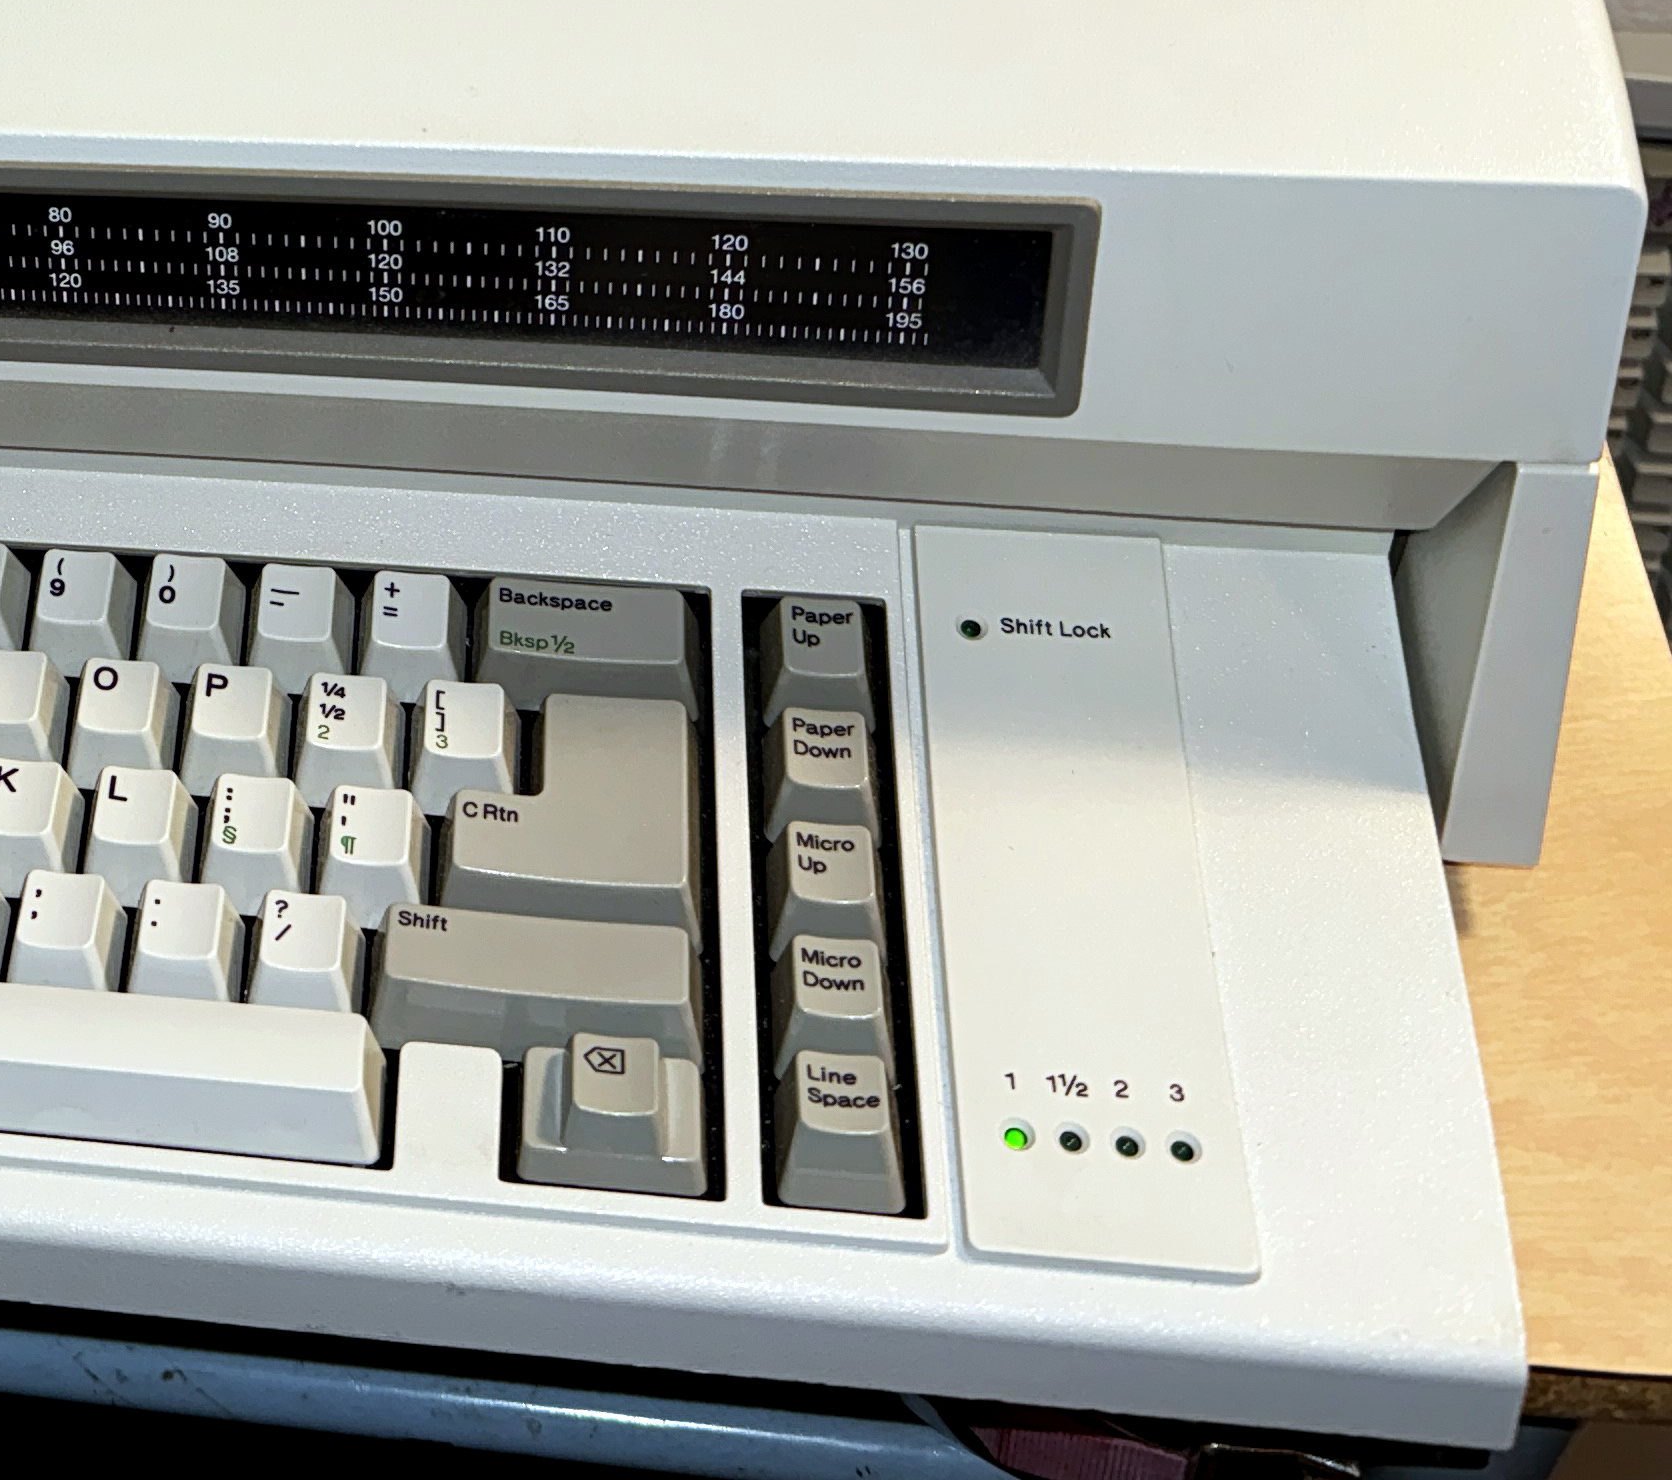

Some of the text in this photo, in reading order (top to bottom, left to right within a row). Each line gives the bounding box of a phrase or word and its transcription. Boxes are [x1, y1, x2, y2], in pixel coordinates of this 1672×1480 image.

[49, 207, 71, 222] 80
[208, 213, 232, 228] 90
[368, 220, 402, 236] 100
[536, 227, 570, 243] 110
[712, 235, 748, 251] 120
[892, 243, 928, 259] 130
[51, 240, 74, 255] 96
[206, 247, 239, 262] 108
[369, 254, 402, 269] 120
[535, 261, 570, 277] 132
[711, 269, 745, 285] 144
[889, 278, 925, 294] 156
[50, 273, 81, 288] 120
[207, 279, 240, 295] 135
[369, 287, 403, 302] 150
[535, 295, 569, 310] 165
[709, 304, 744, 319] 180
[886, 312, 922, 328] 195
[57, 558, 64, 575] (
[168, 565, 174, 582] )
[50, 578, 65, 596] 9
[159, 586, 175, 604] 0
[500, 588, 612, 611] Backspace
[792, 606, 853, 626] Paper
[793, 628, 820, 647] Up
[1001, 618, 1110, 638] Shift Lock
[94, 667, 118, 690] O
[206, 673, 228, 697] P
[318, 725, 329, 739] 2
[792, 717, 854, 738] Paper
[436, 734, 448, 749] 3
[794, 739, 851, 758] Down
[109, 775, 127, 801] L
[463, 802, 518, 822] C Rtn
[797, 832, 855, 852] Micro
[798, 855, 827, 874] Up
[276, 900, 288, 918] ?
[398, 911, 447, 931] Shift
[801, 948, 862, 968] Micro
[803, 971, 864, 991] Down
[807, 1064, 856, 1085] Line
[808, 1087, 880, 1108] Space
[1005, 1073, 1015, 1089] 1
[1114, 1080, 1128, 1098] 2
[1170, 1084, 1184, 1102] 3
